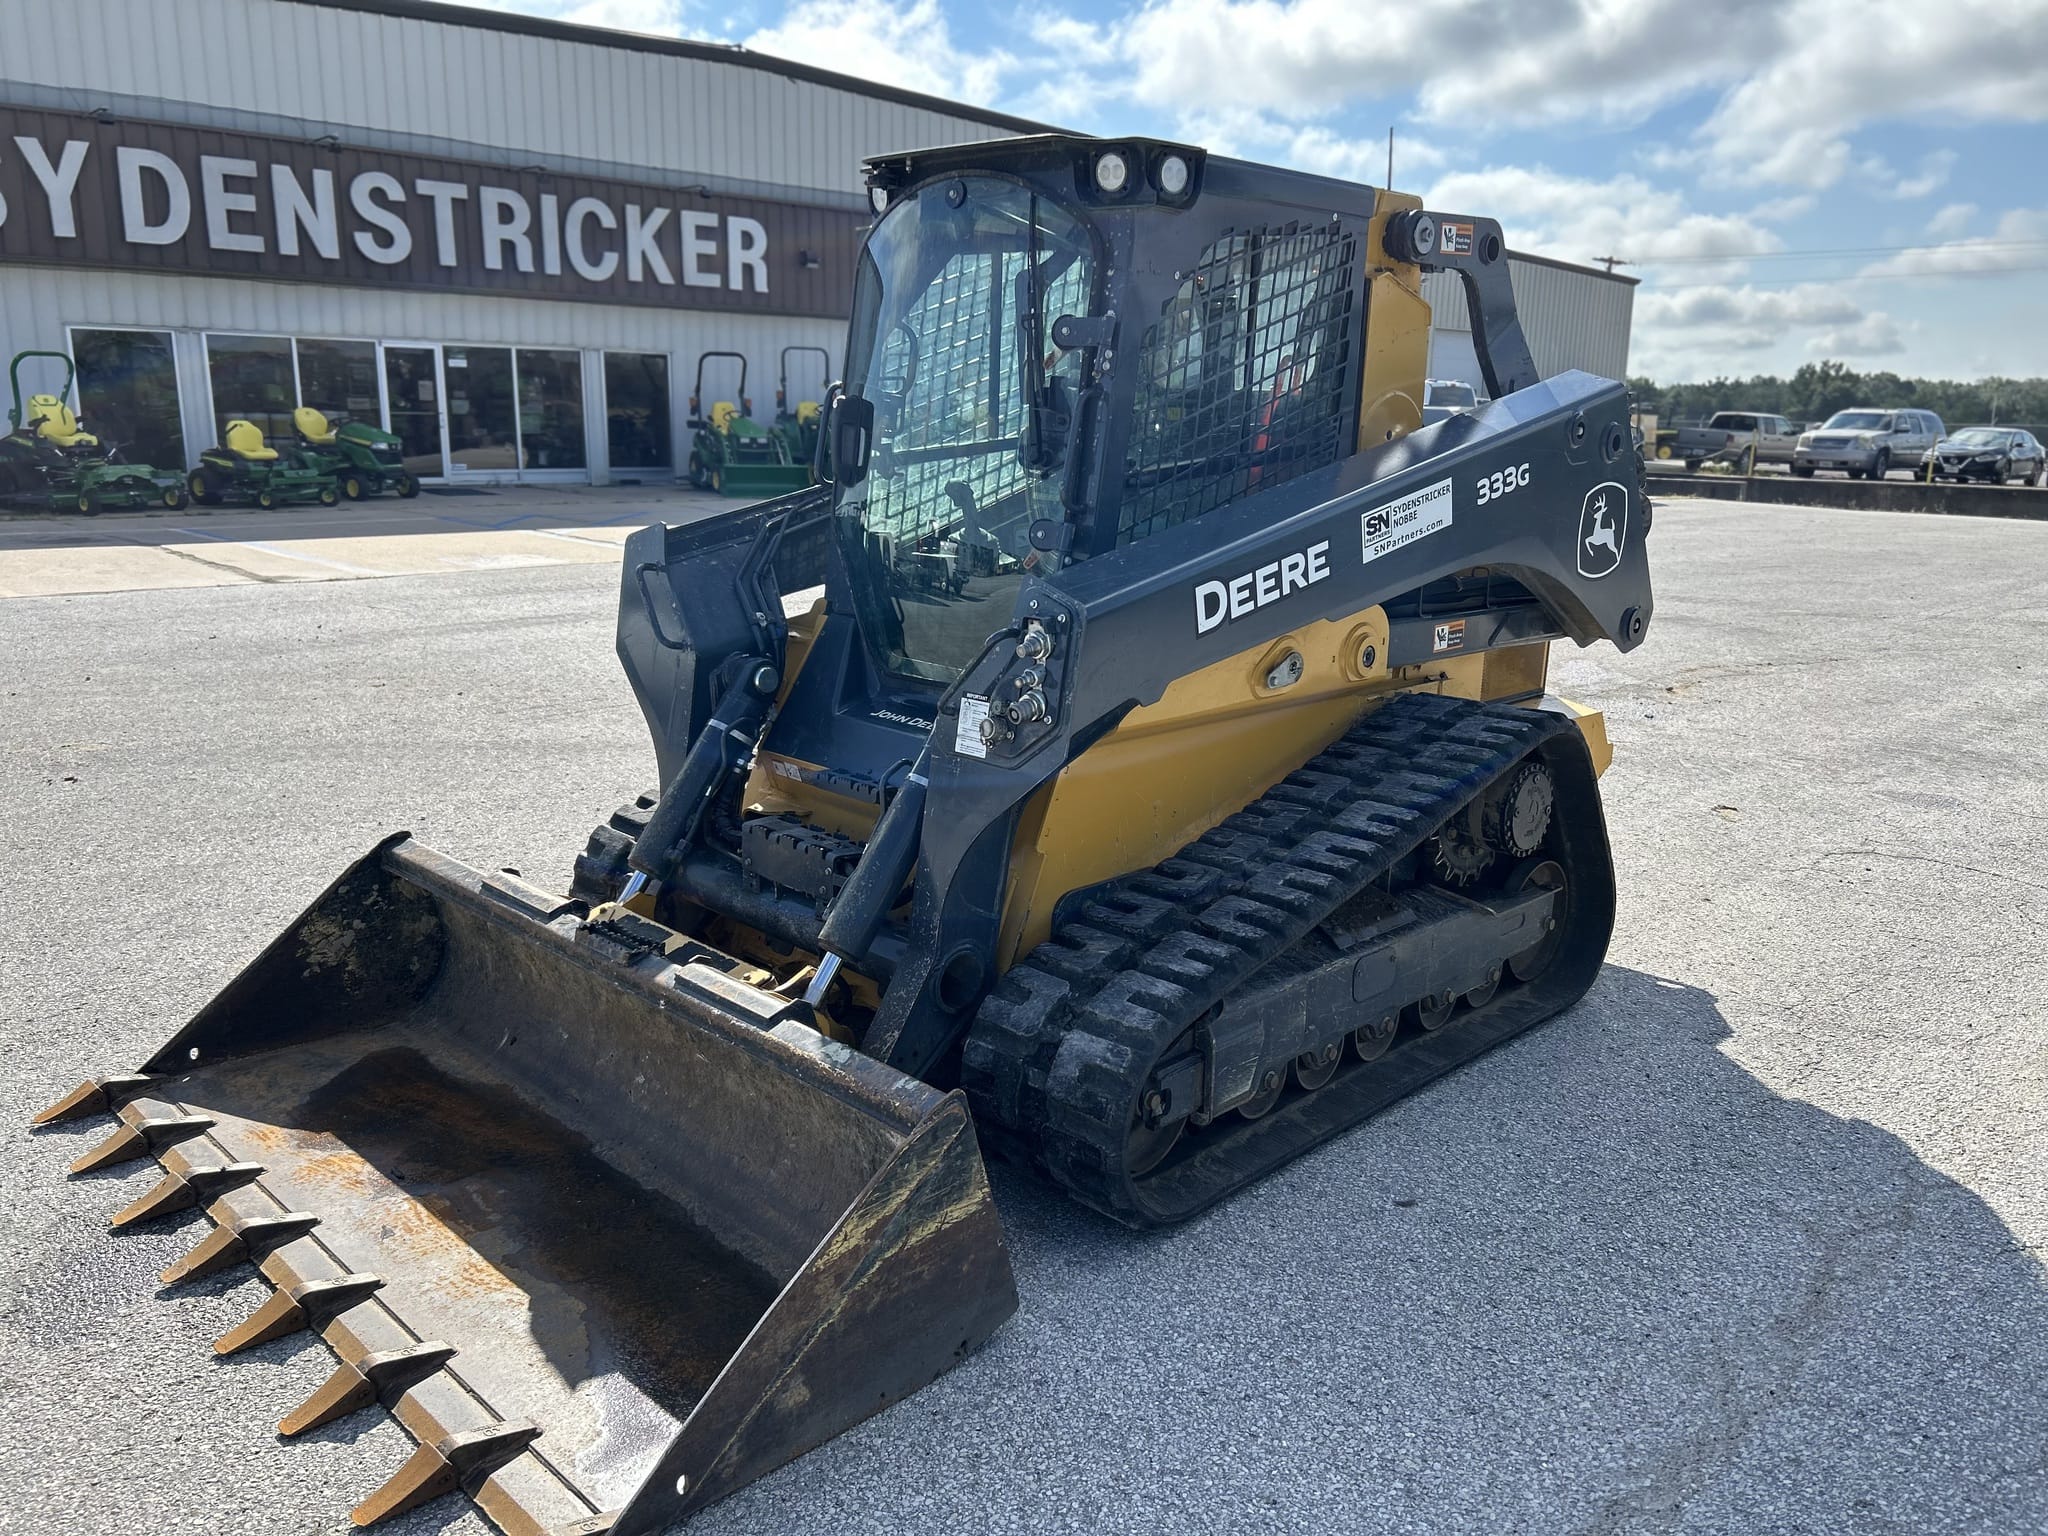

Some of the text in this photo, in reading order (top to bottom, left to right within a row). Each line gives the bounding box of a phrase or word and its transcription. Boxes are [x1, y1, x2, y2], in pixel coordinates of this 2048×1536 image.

[0, 136, 769, 293] YDENSTRICKER
[1393, 484, 1451, 516] SYDENSTRICKER
[1477, 463, 1530, 505] 333G
[1366, 510, 1390, 536] SN
[1393, 510, 1418, 528] NOBBE
[1366, 530, 1390, 544] PARTNERS
[1374, 518, 1443, 556] SNPartners.com
[1195, 540, 1330, 634] DEERE
[870, 709, 911, 723] JOHN
